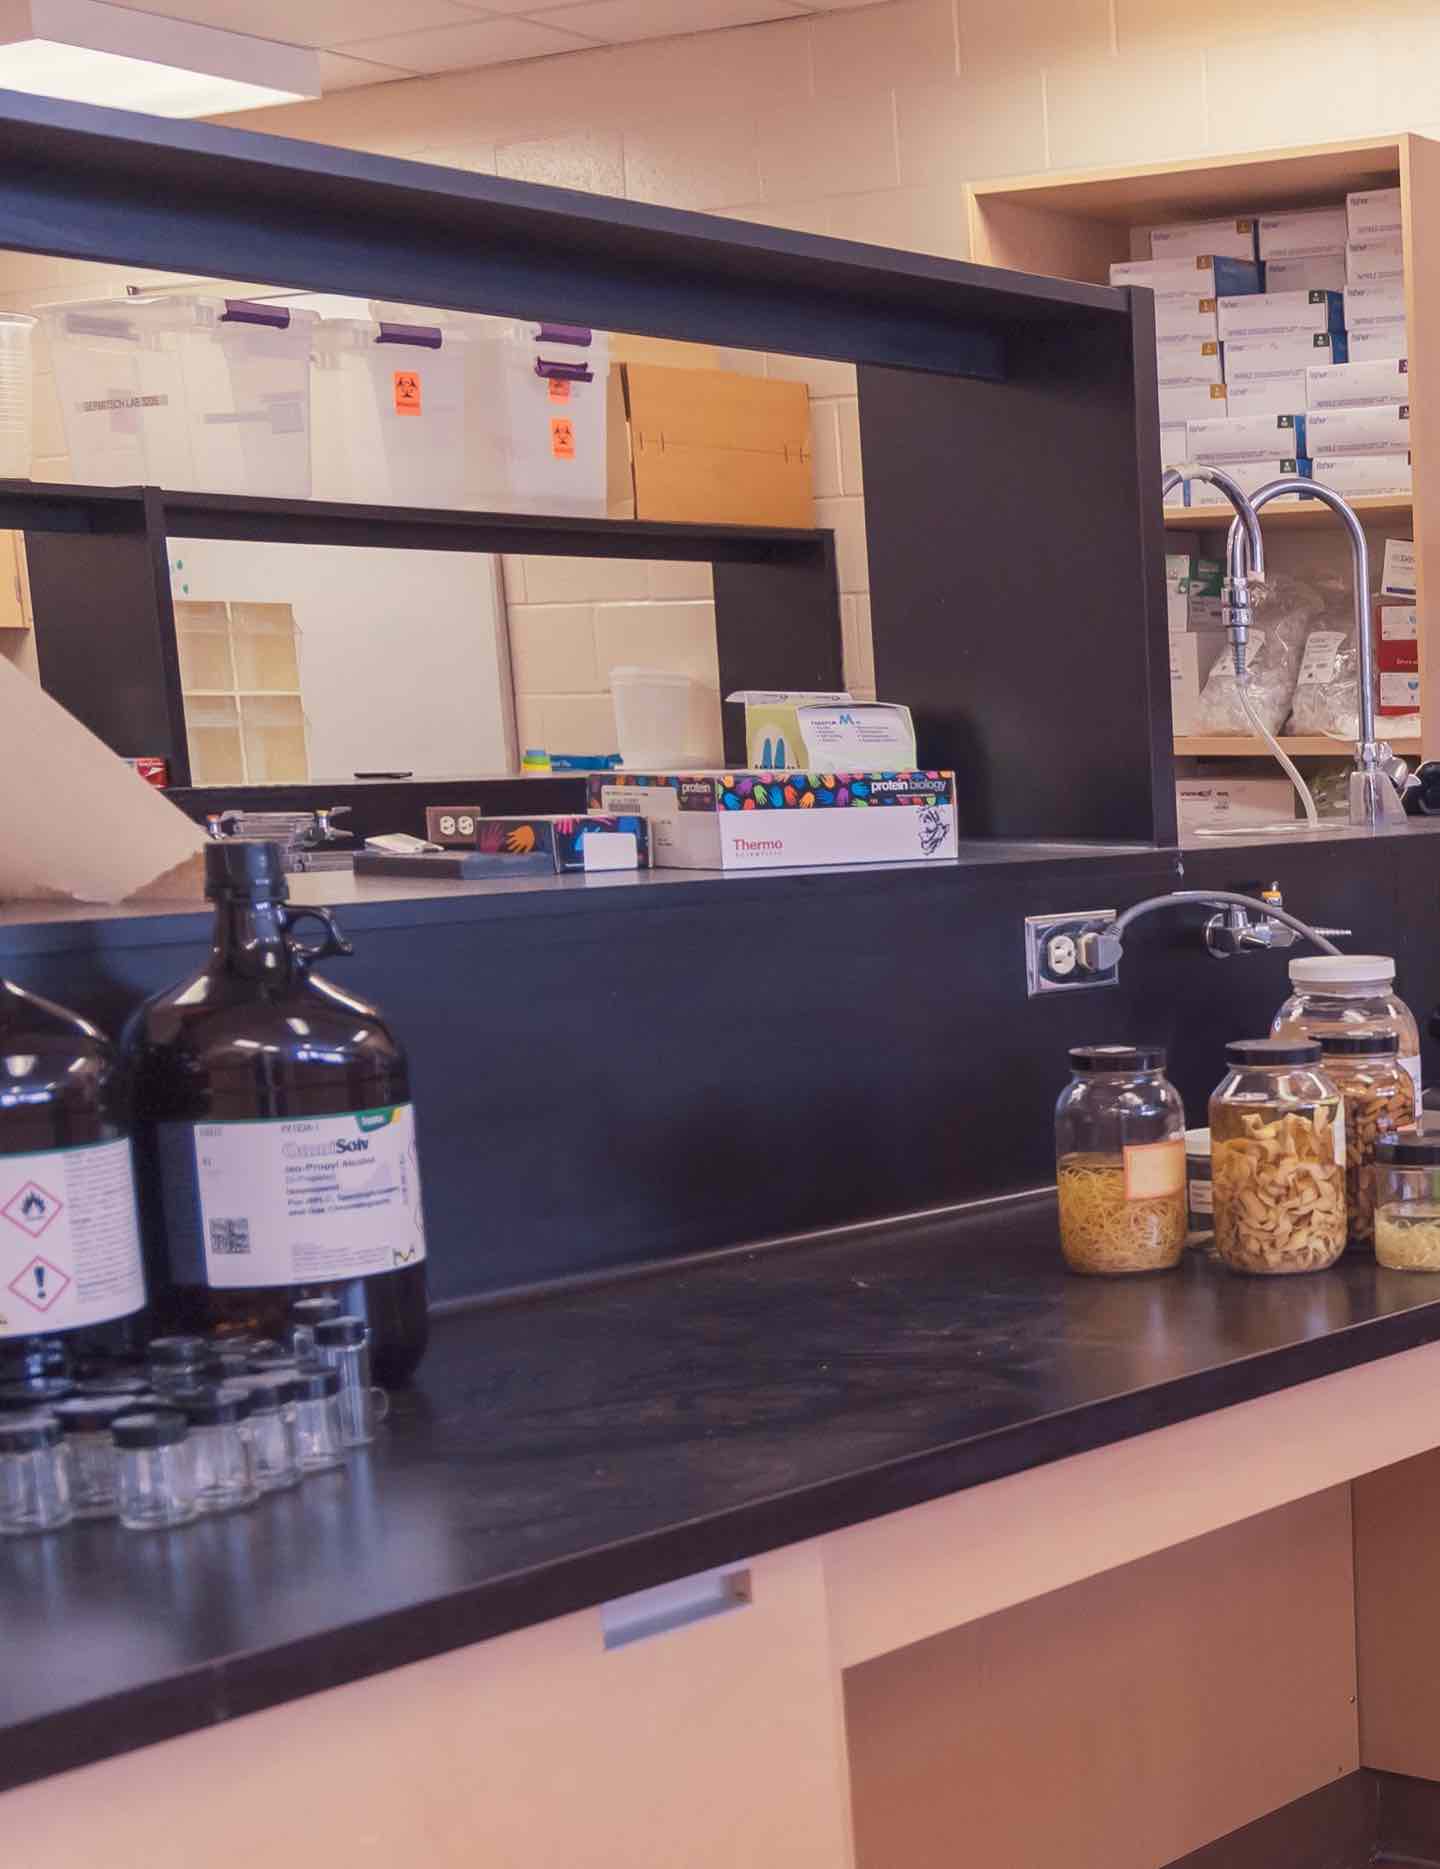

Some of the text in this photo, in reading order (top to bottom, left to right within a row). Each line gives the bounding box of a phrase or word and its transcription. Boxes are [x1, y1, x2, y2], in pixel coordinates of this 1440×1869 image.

[681, 782, 711, 797] protein
[871, 778, 946, 793] protein biology
[734, 838, 783, 851] Thermo
